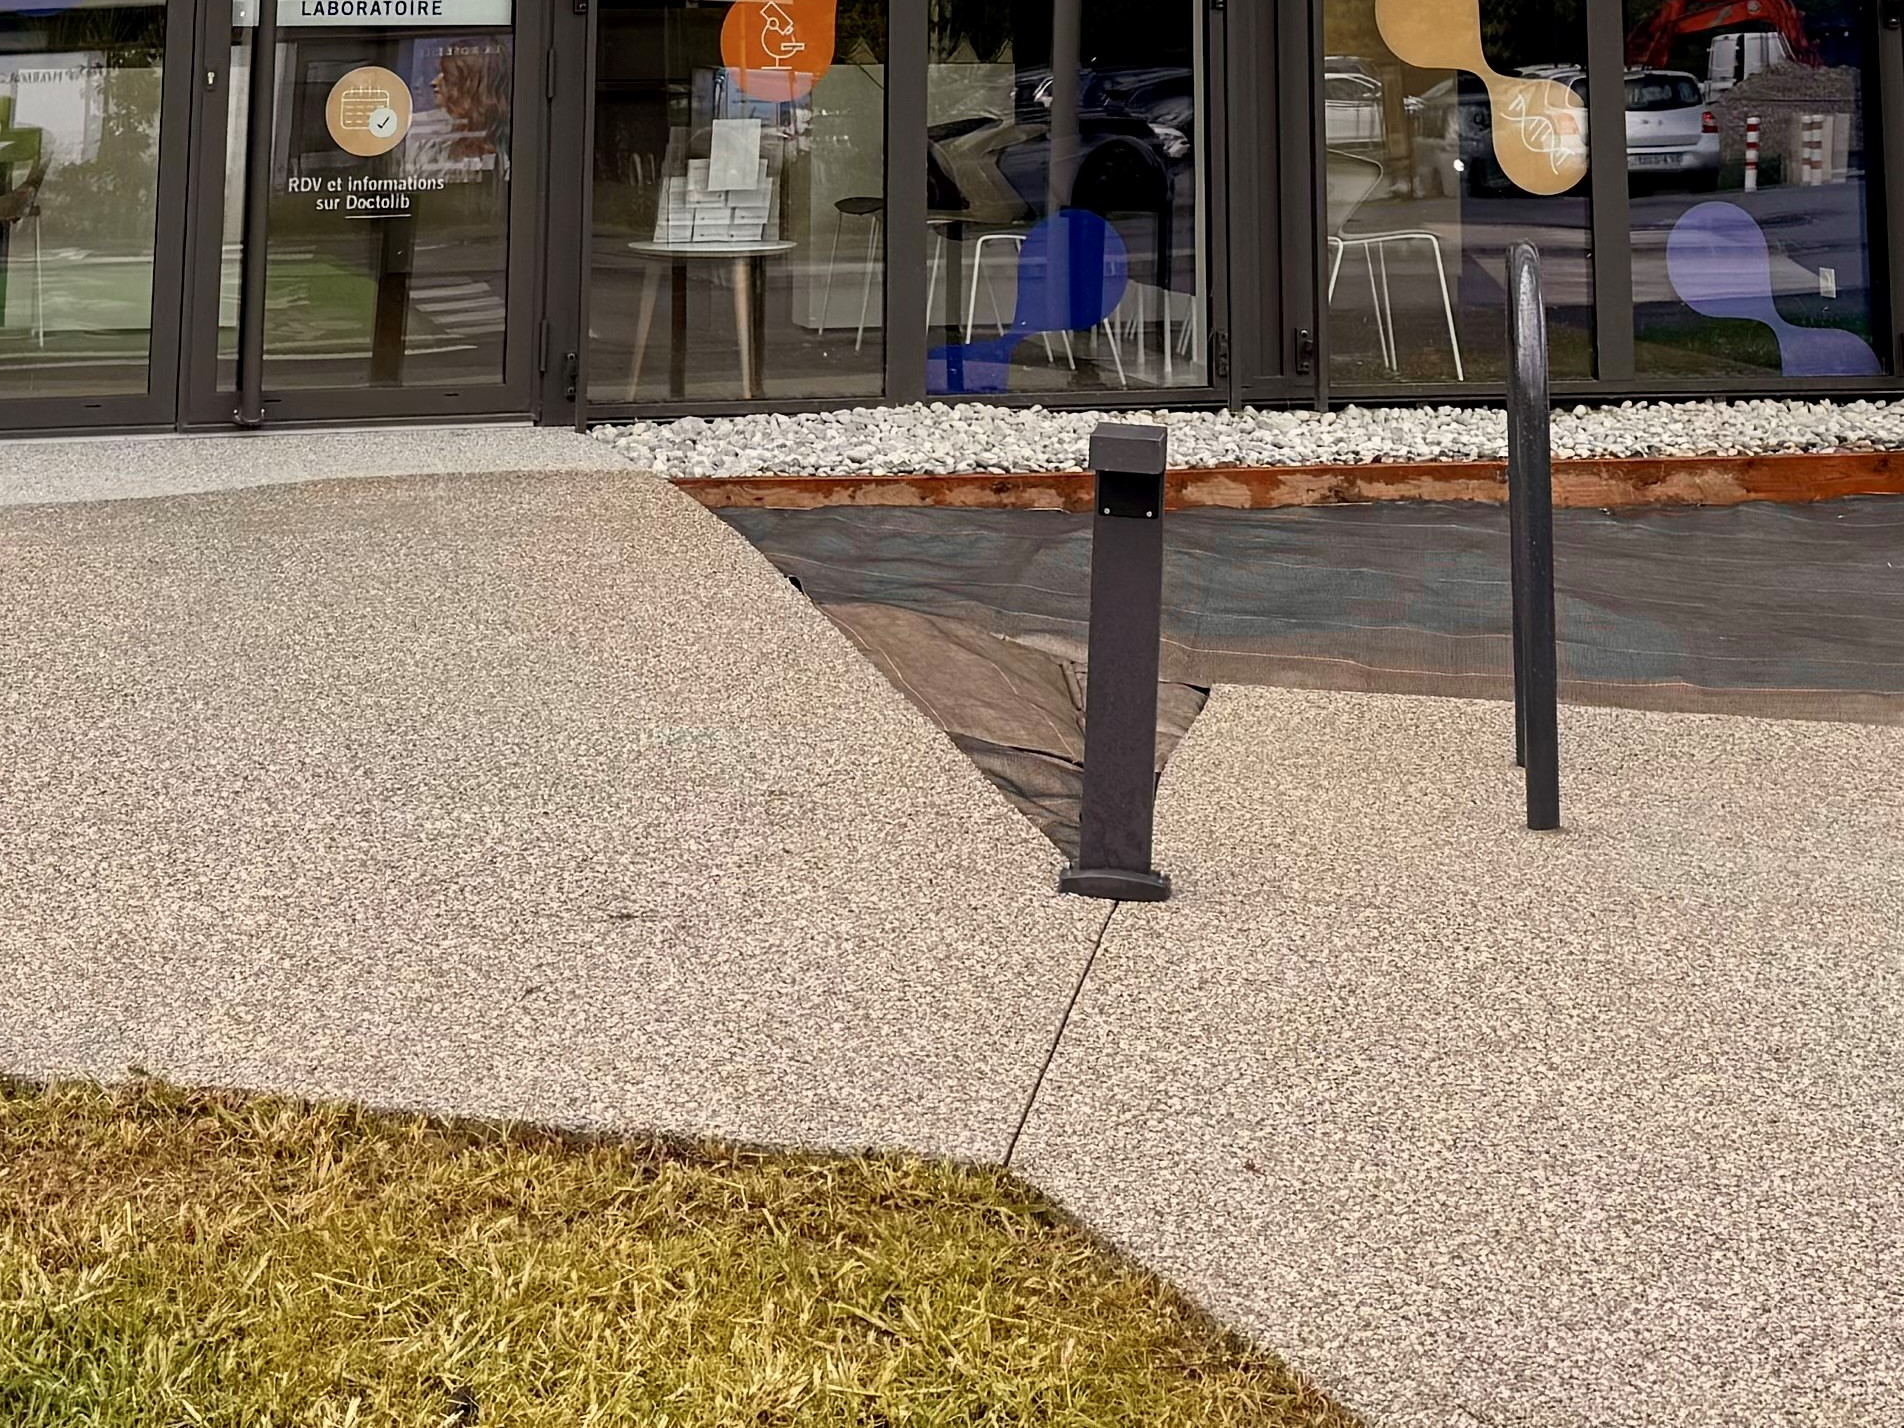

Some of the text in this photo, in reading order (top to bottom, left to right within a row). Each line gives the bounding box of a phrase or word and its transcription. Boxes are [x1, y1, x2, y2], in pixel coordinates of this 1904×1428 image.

[301, 0, 443, 16] LABORATOIRE
[288, 177, 322, 192] RDV
[327, 178, 342, 192] et
[315, 193, 411, 211] sur Doctolib
